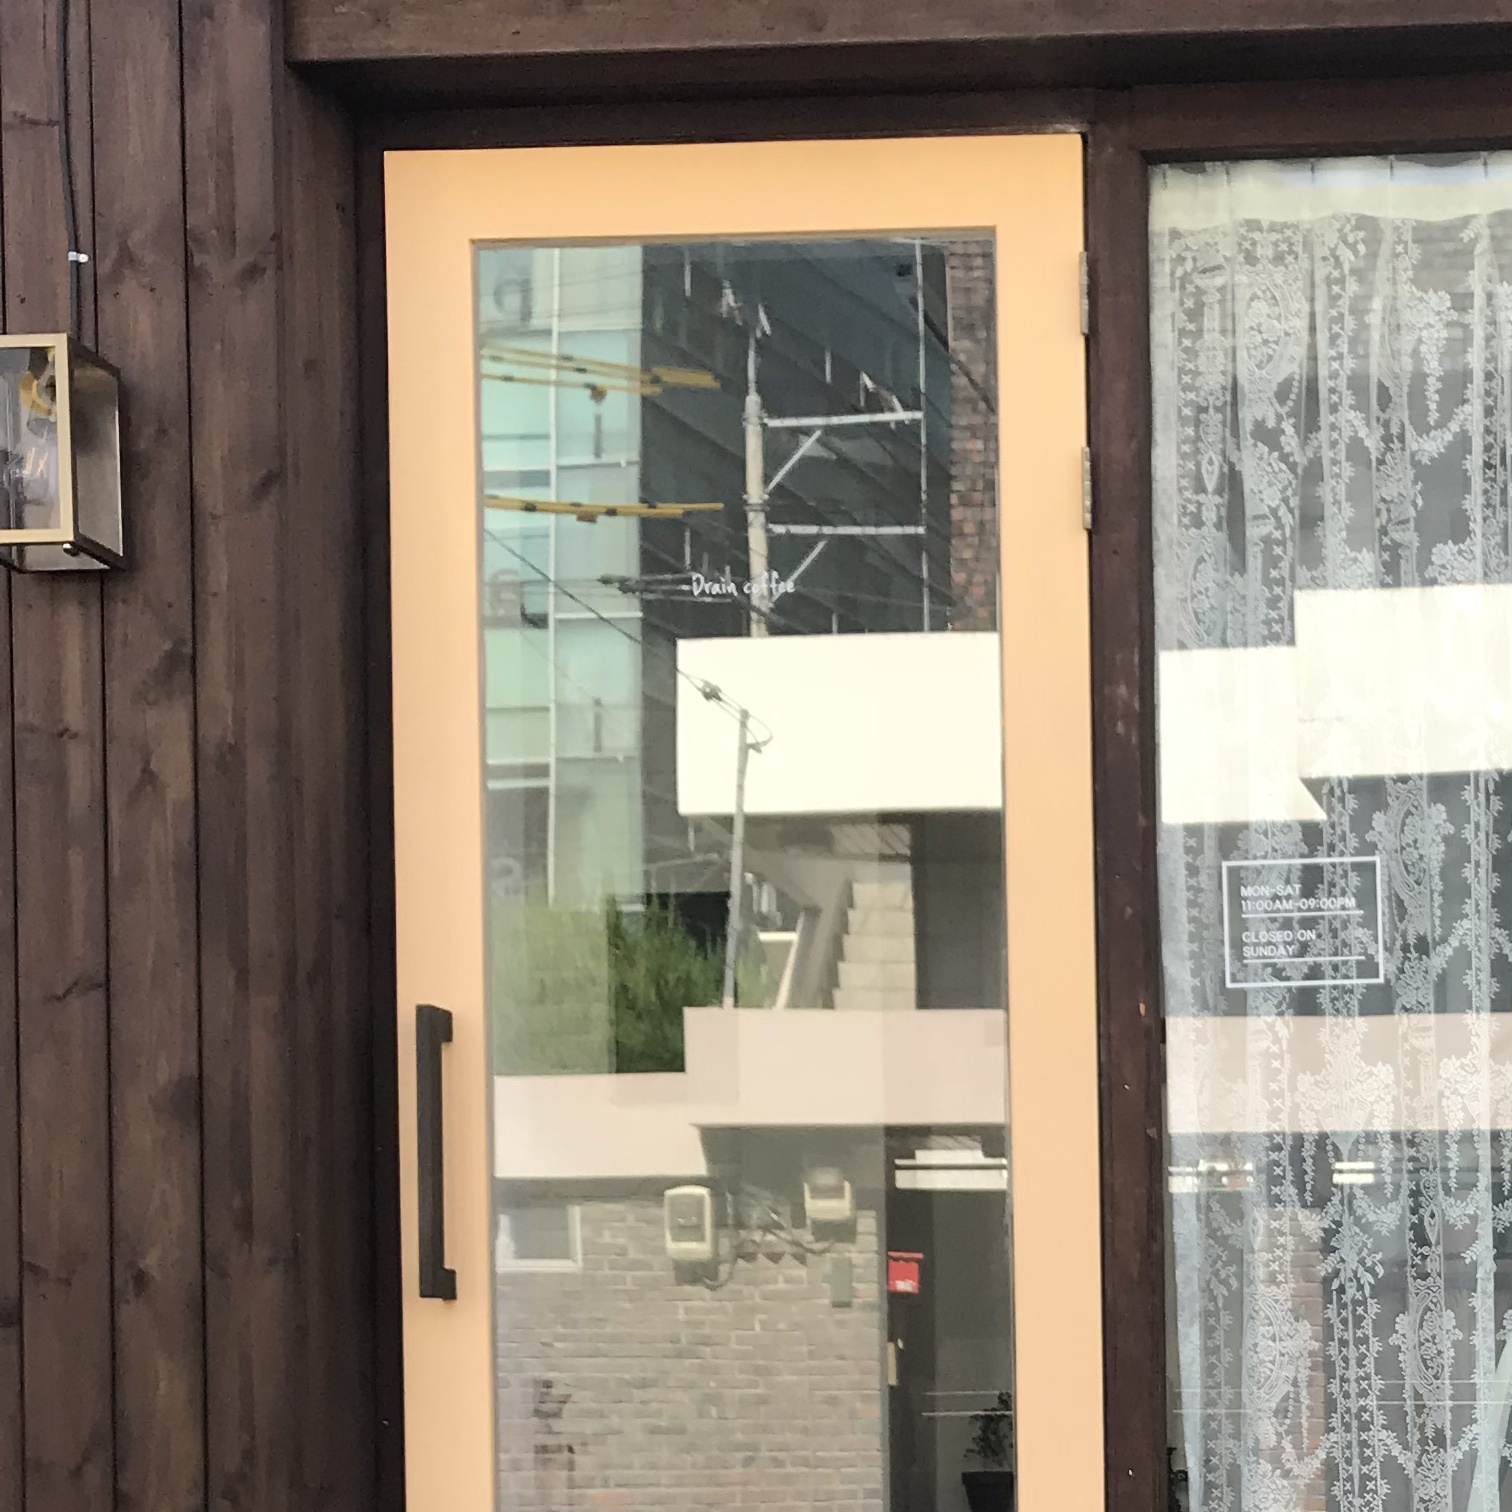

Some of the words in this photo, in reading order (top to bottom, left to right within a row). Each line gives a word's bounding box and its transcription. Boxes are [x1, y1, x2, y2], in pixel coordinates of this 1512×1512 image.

[691, 572, 738, 597] Drain
[743, 569, 796, 596] coffee
[1241, 884, 1301, 897] MON-SAT
[1241, 897, 1356, 911] 11:00AM-09:00PM
[1241, 930, 1293, 943] CLOSED
[1297, 928, 1316, 941] ON
[1243, 944, 1295, 957] SUNDAY
